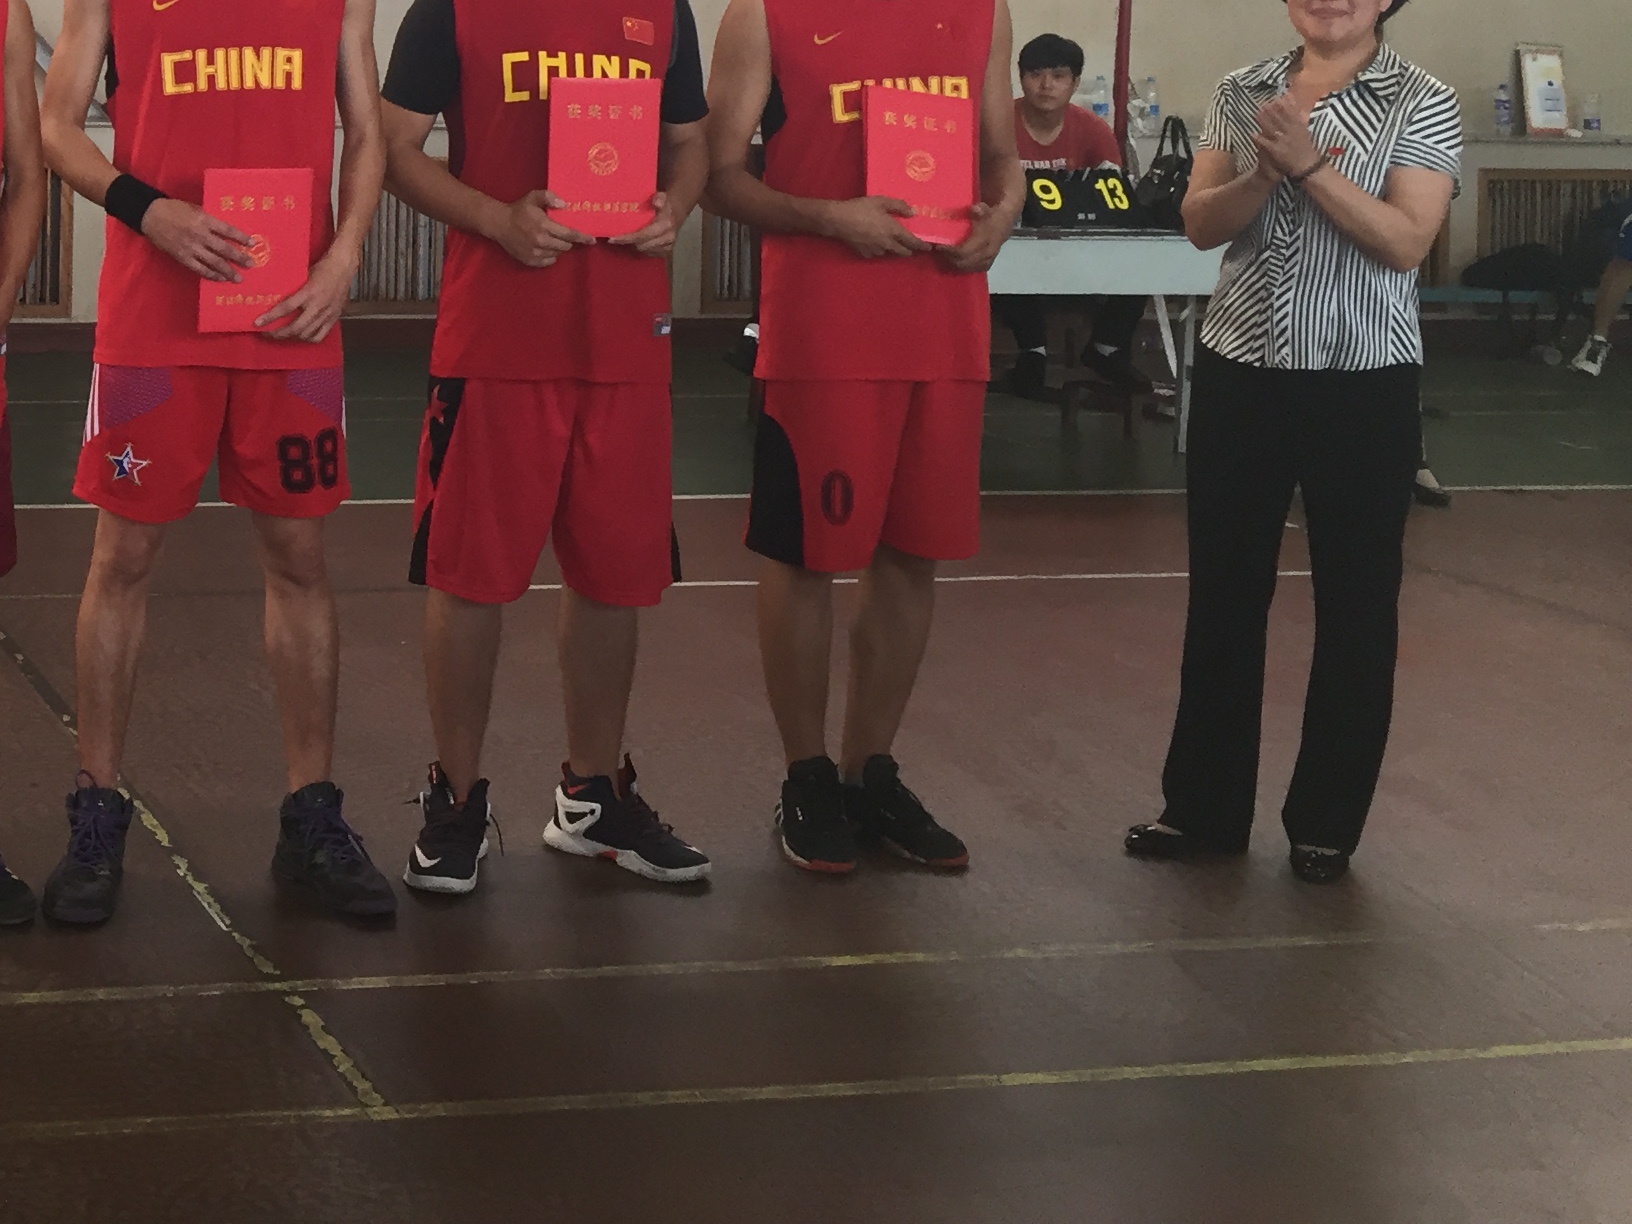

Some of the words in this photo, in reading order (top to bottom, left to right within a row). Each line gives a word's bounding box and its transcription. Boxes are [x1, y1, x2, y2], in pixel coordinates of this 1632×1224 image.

[160, 45, 304, 96] CHINA
[1032, 178, 1063, 210] 9
[1094, 177, 1130, 210] 13
[276, 426, 340, 495] 88
[821, 468, 855, 526] 0
